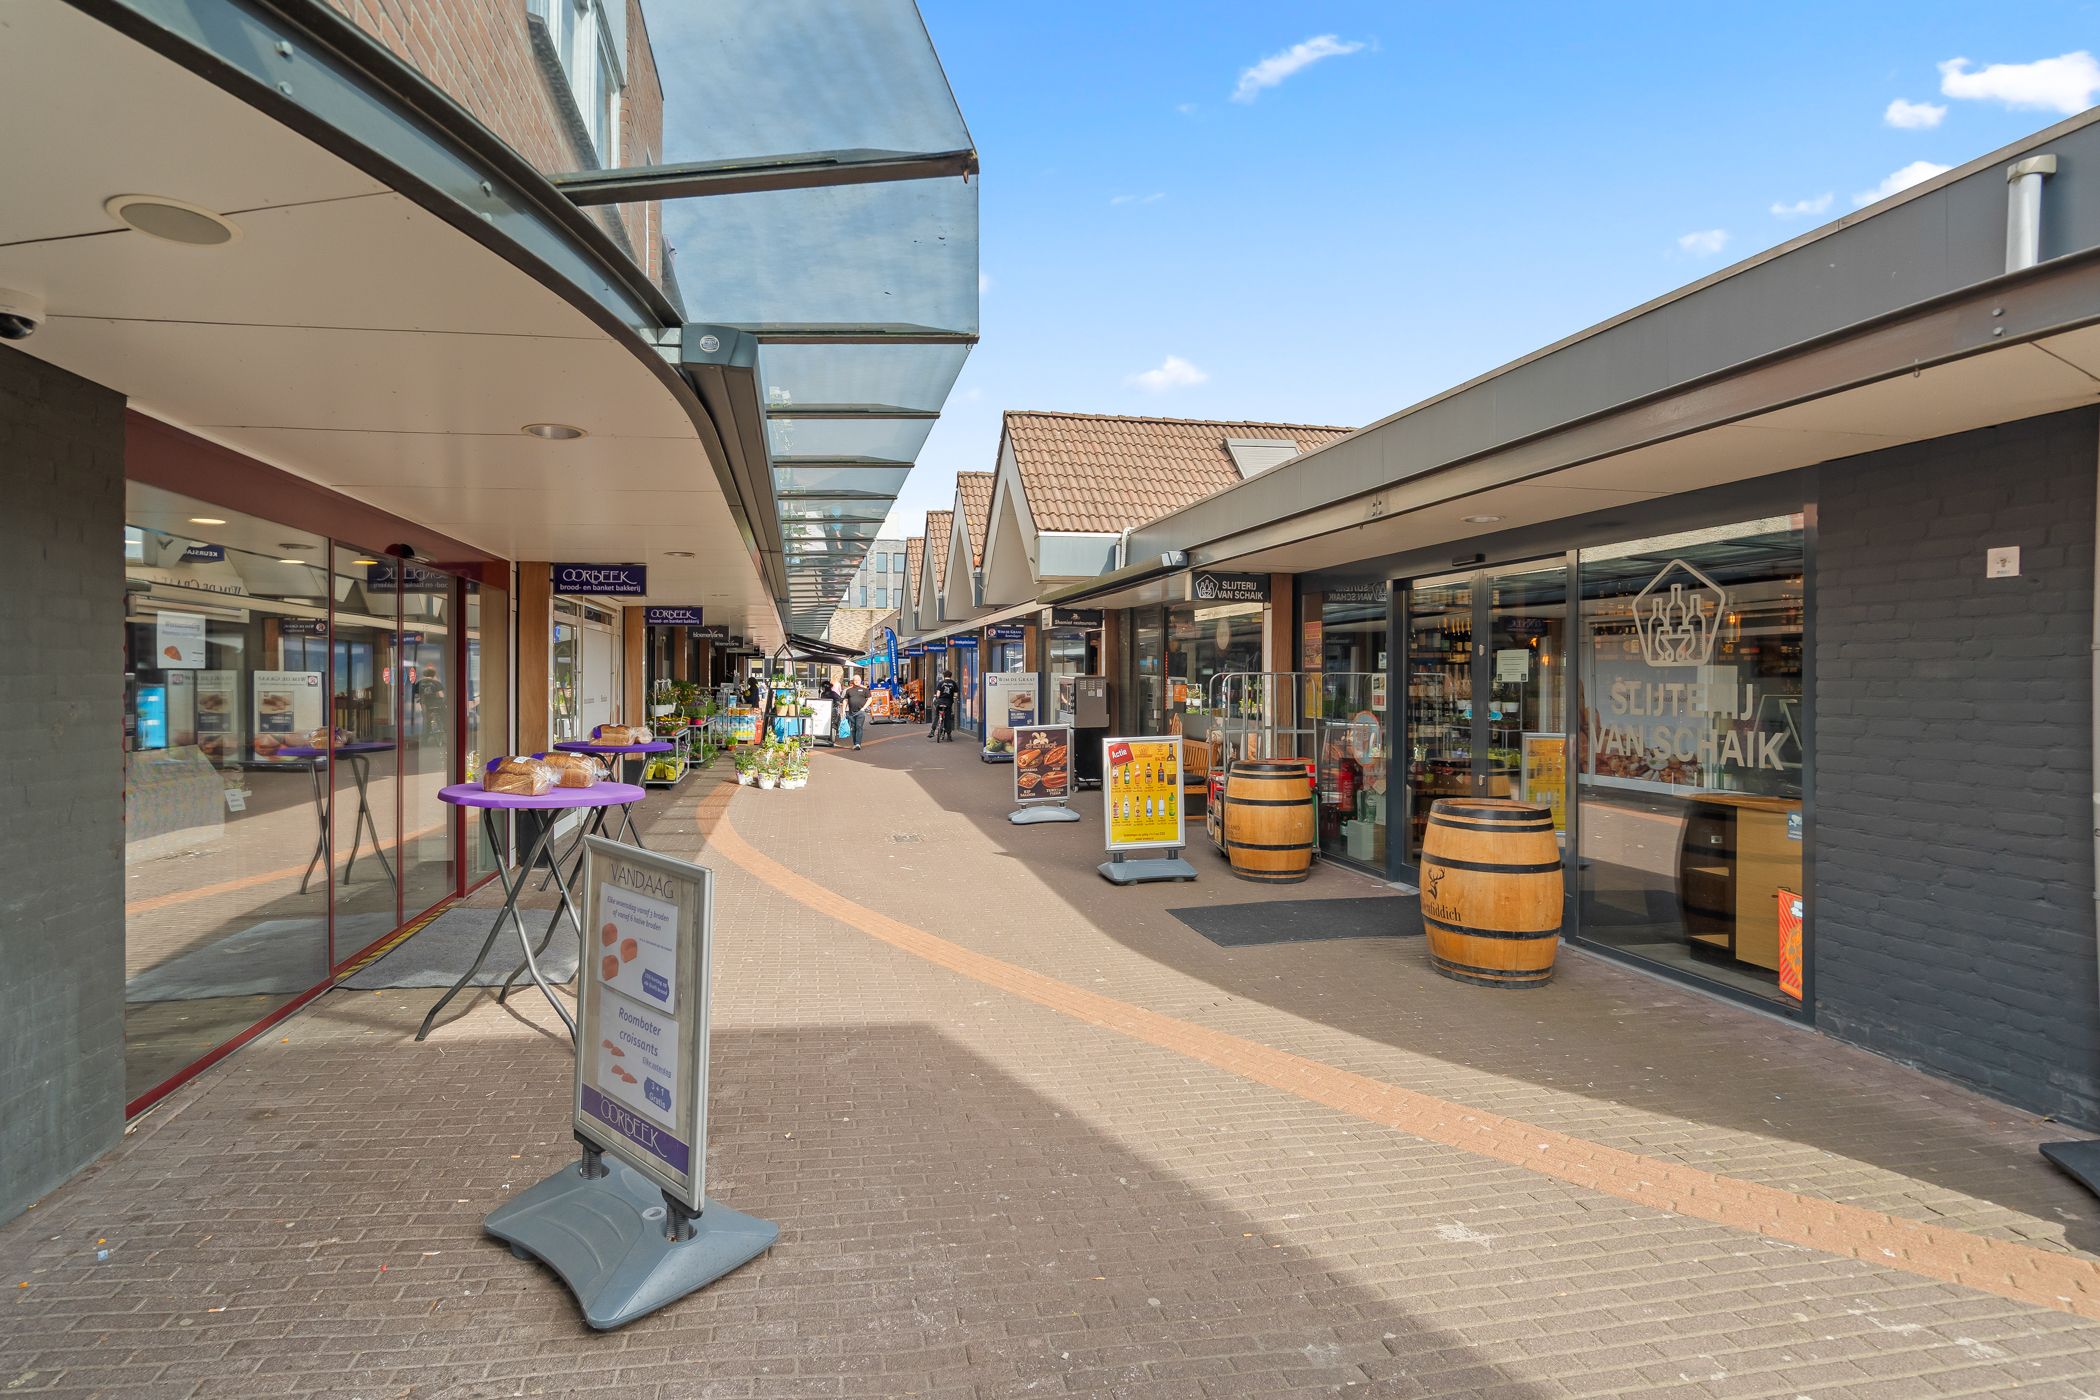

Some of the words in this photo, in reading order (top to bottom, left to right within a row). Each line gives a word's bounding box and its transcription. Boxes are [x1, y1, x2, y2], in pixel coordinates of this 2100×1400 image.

[562, 568, 638, 585] OORBEEK
[559, 583, 582, 591] brood-
[615, 585, 641, 593] bakkerij
[1221, 580, 1257, 591] SLIJTERIJ
[1217, 590, 1234, 599] VAN
[1234, 590, 1264, 600] SCHAIK
[1111, 748, 1128, 759] Actie
[1589, 722, 1644, 757] VAN
[1652, 725, 1785, 771] SCHAIK
[611, 863, 674, 899] VANDAAG
[618, 1007, 662, 1036] Roomboter
[619, 1030, 659, 1057] croissants
[649, 1091, 666, 1109] Gratis
